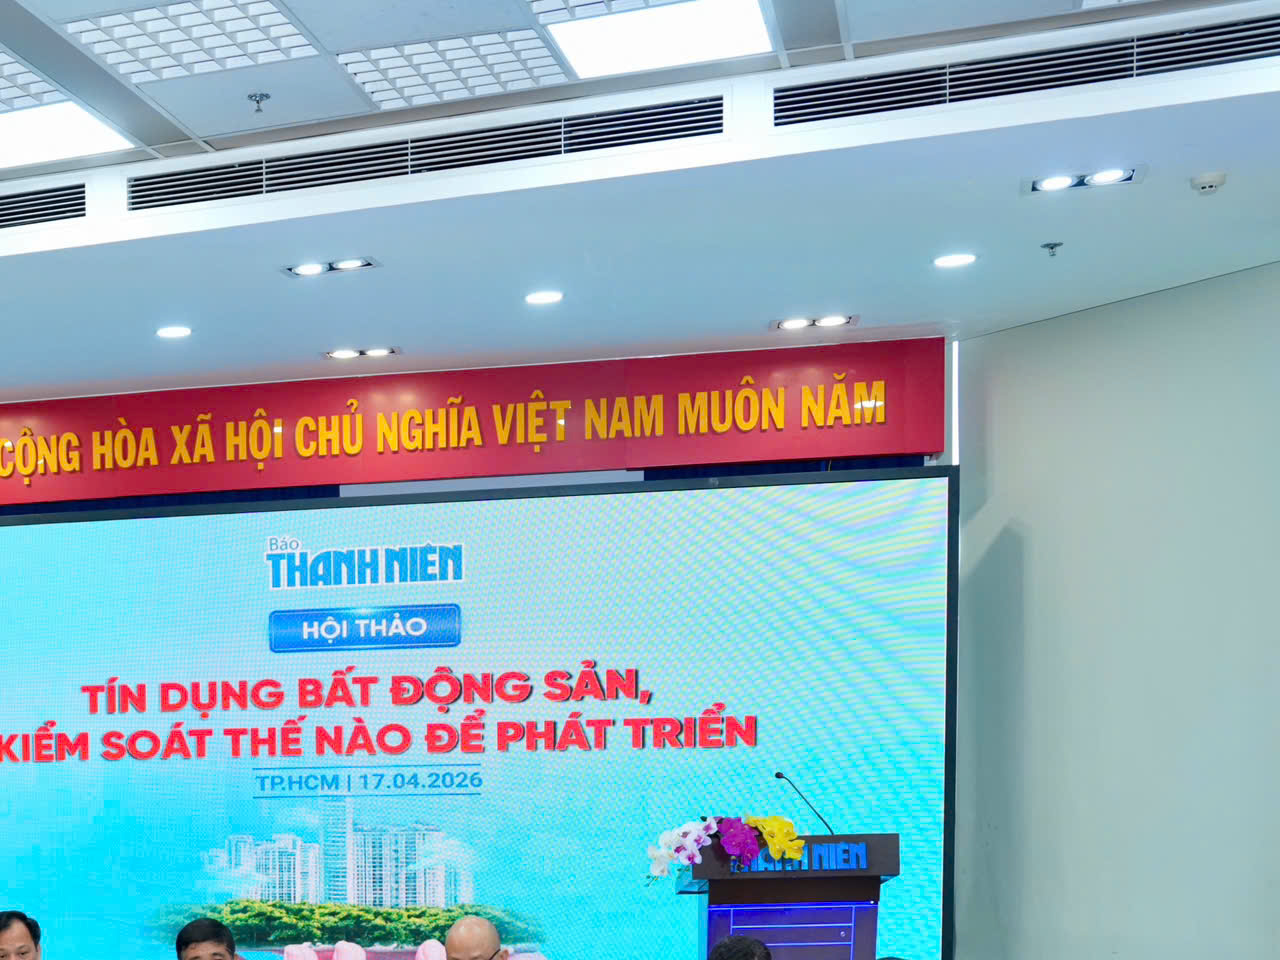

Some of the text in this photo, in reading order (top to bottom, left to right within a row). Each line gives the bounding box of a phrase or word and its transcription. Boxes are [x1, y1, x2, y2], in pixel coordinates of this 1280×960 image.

[92, 418, 158, 470] HÒA
[170, 413, 216, 465] XÃ
[225, 408, 284, 470] HỘI
[294, 398, 364, 457] CHỦ
[376, 396, 483, 453] NGHĨA
[492, 389, 572, 453] VIỆT
[584, 394, 665, 440] NAM
[678, 376, 786, 436] MUÔN
[801, 372, 887, 428] NĂM
[269, 537, 300, 551] Báo
[266, 543, 463, 588] THANH NIÊN
[303, 612, 427, 644] HỘI THẢO
[81, 660, 652, 719] TÍN DỤNG BẤT ĐỘNG SẢN,
[101, 721, 213, 760] SOÁT
[223, 715, 308, 757] THẾ
[316, 717, 413, 756] NÀO
[424, 708, 486, 754] ĐỂ
[497, 712, 615, 752] PHÁT
[623, 702, 757, 749] TRIỂN
[256, 772, 483, 792] TP.HCM 17.04.2026
[812, 841, 867, 870] NIÊN
